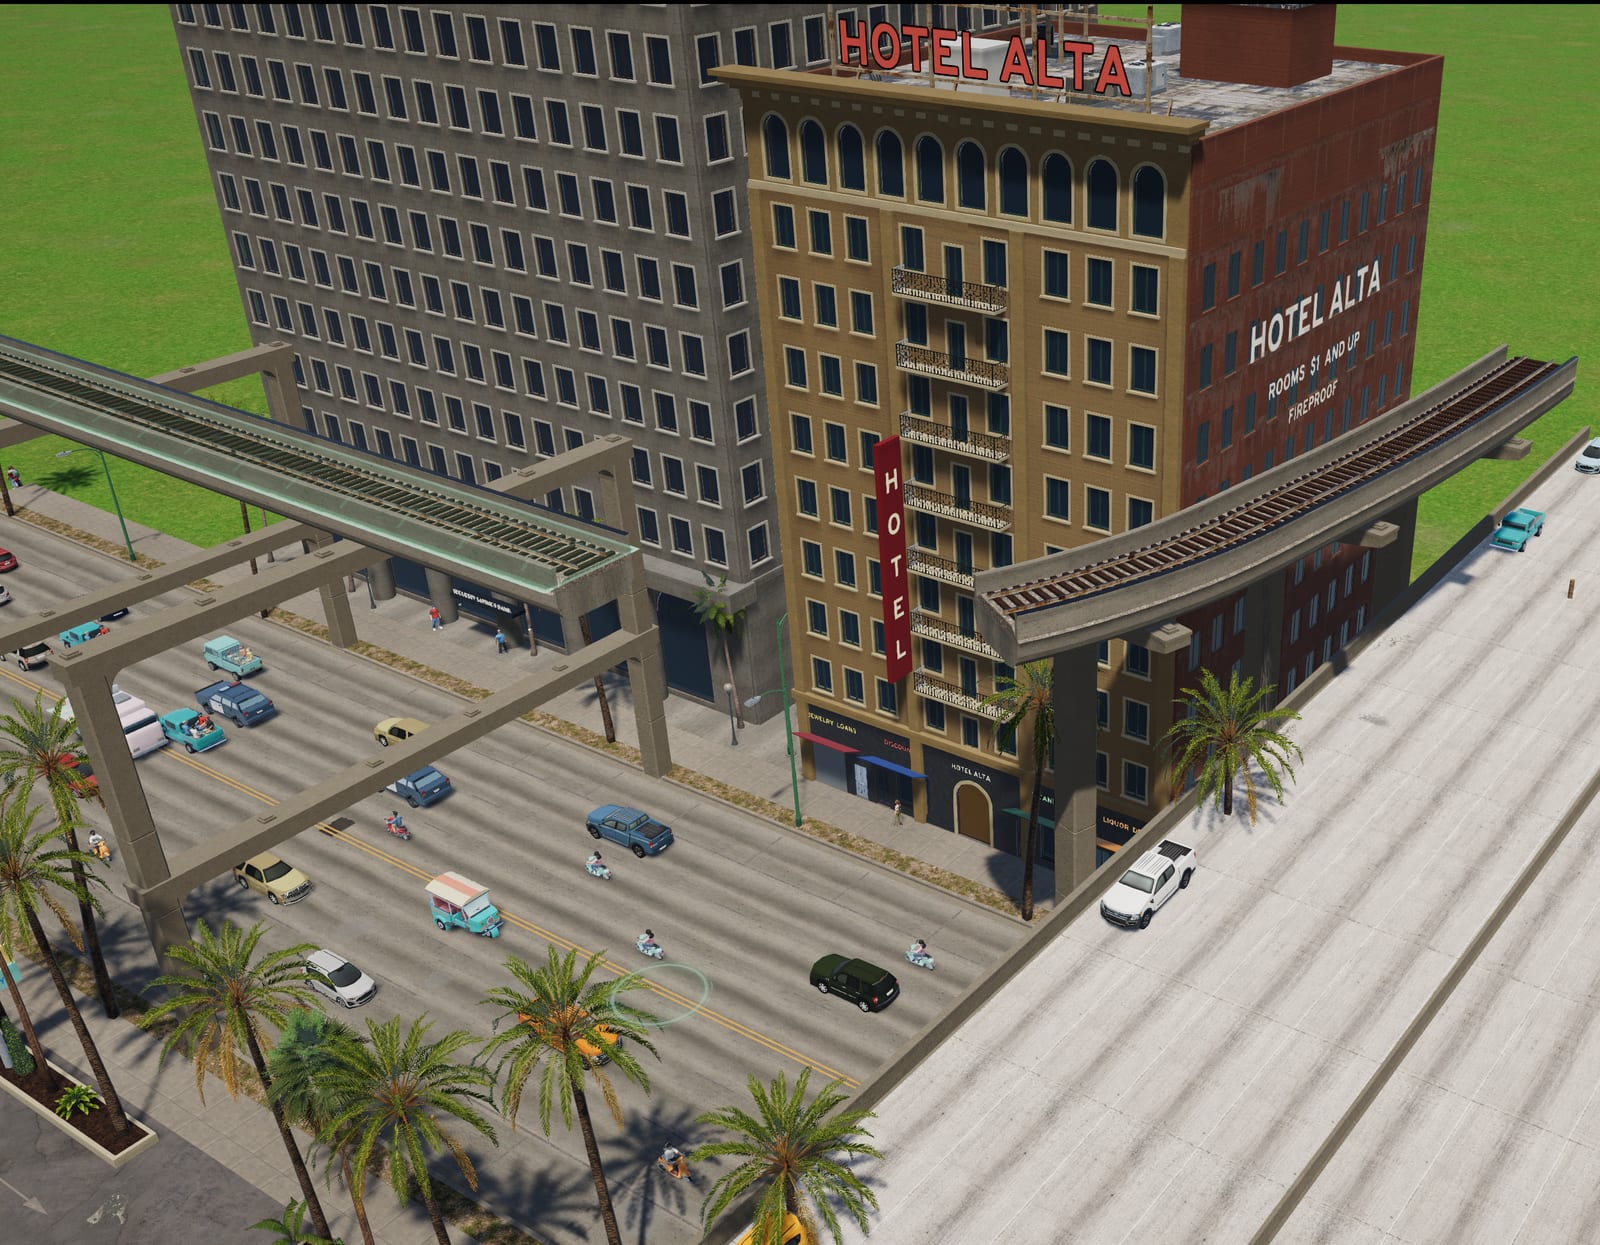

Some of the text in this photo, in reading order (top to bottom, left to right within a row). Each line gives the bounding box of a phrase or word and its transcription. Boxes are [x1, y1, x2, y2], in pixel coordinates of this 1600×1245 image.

[839, 18, 1132, 97] HOTEL ALTA
[1249, 260, 1381, 365] HOTEL ALTA
[1268, 331, 1360, 401] ROOMS $1 AND UP
[1288, 379, 1338, 424] FIREPROOF
[885, 468, 907, 661] HOTEL
[808, 711, 857, 735] JEWELRY LOANS
[951, 763, 991, 783] HOTEL ALTA
[1102, 816, 1129, 831] LIQUOR
